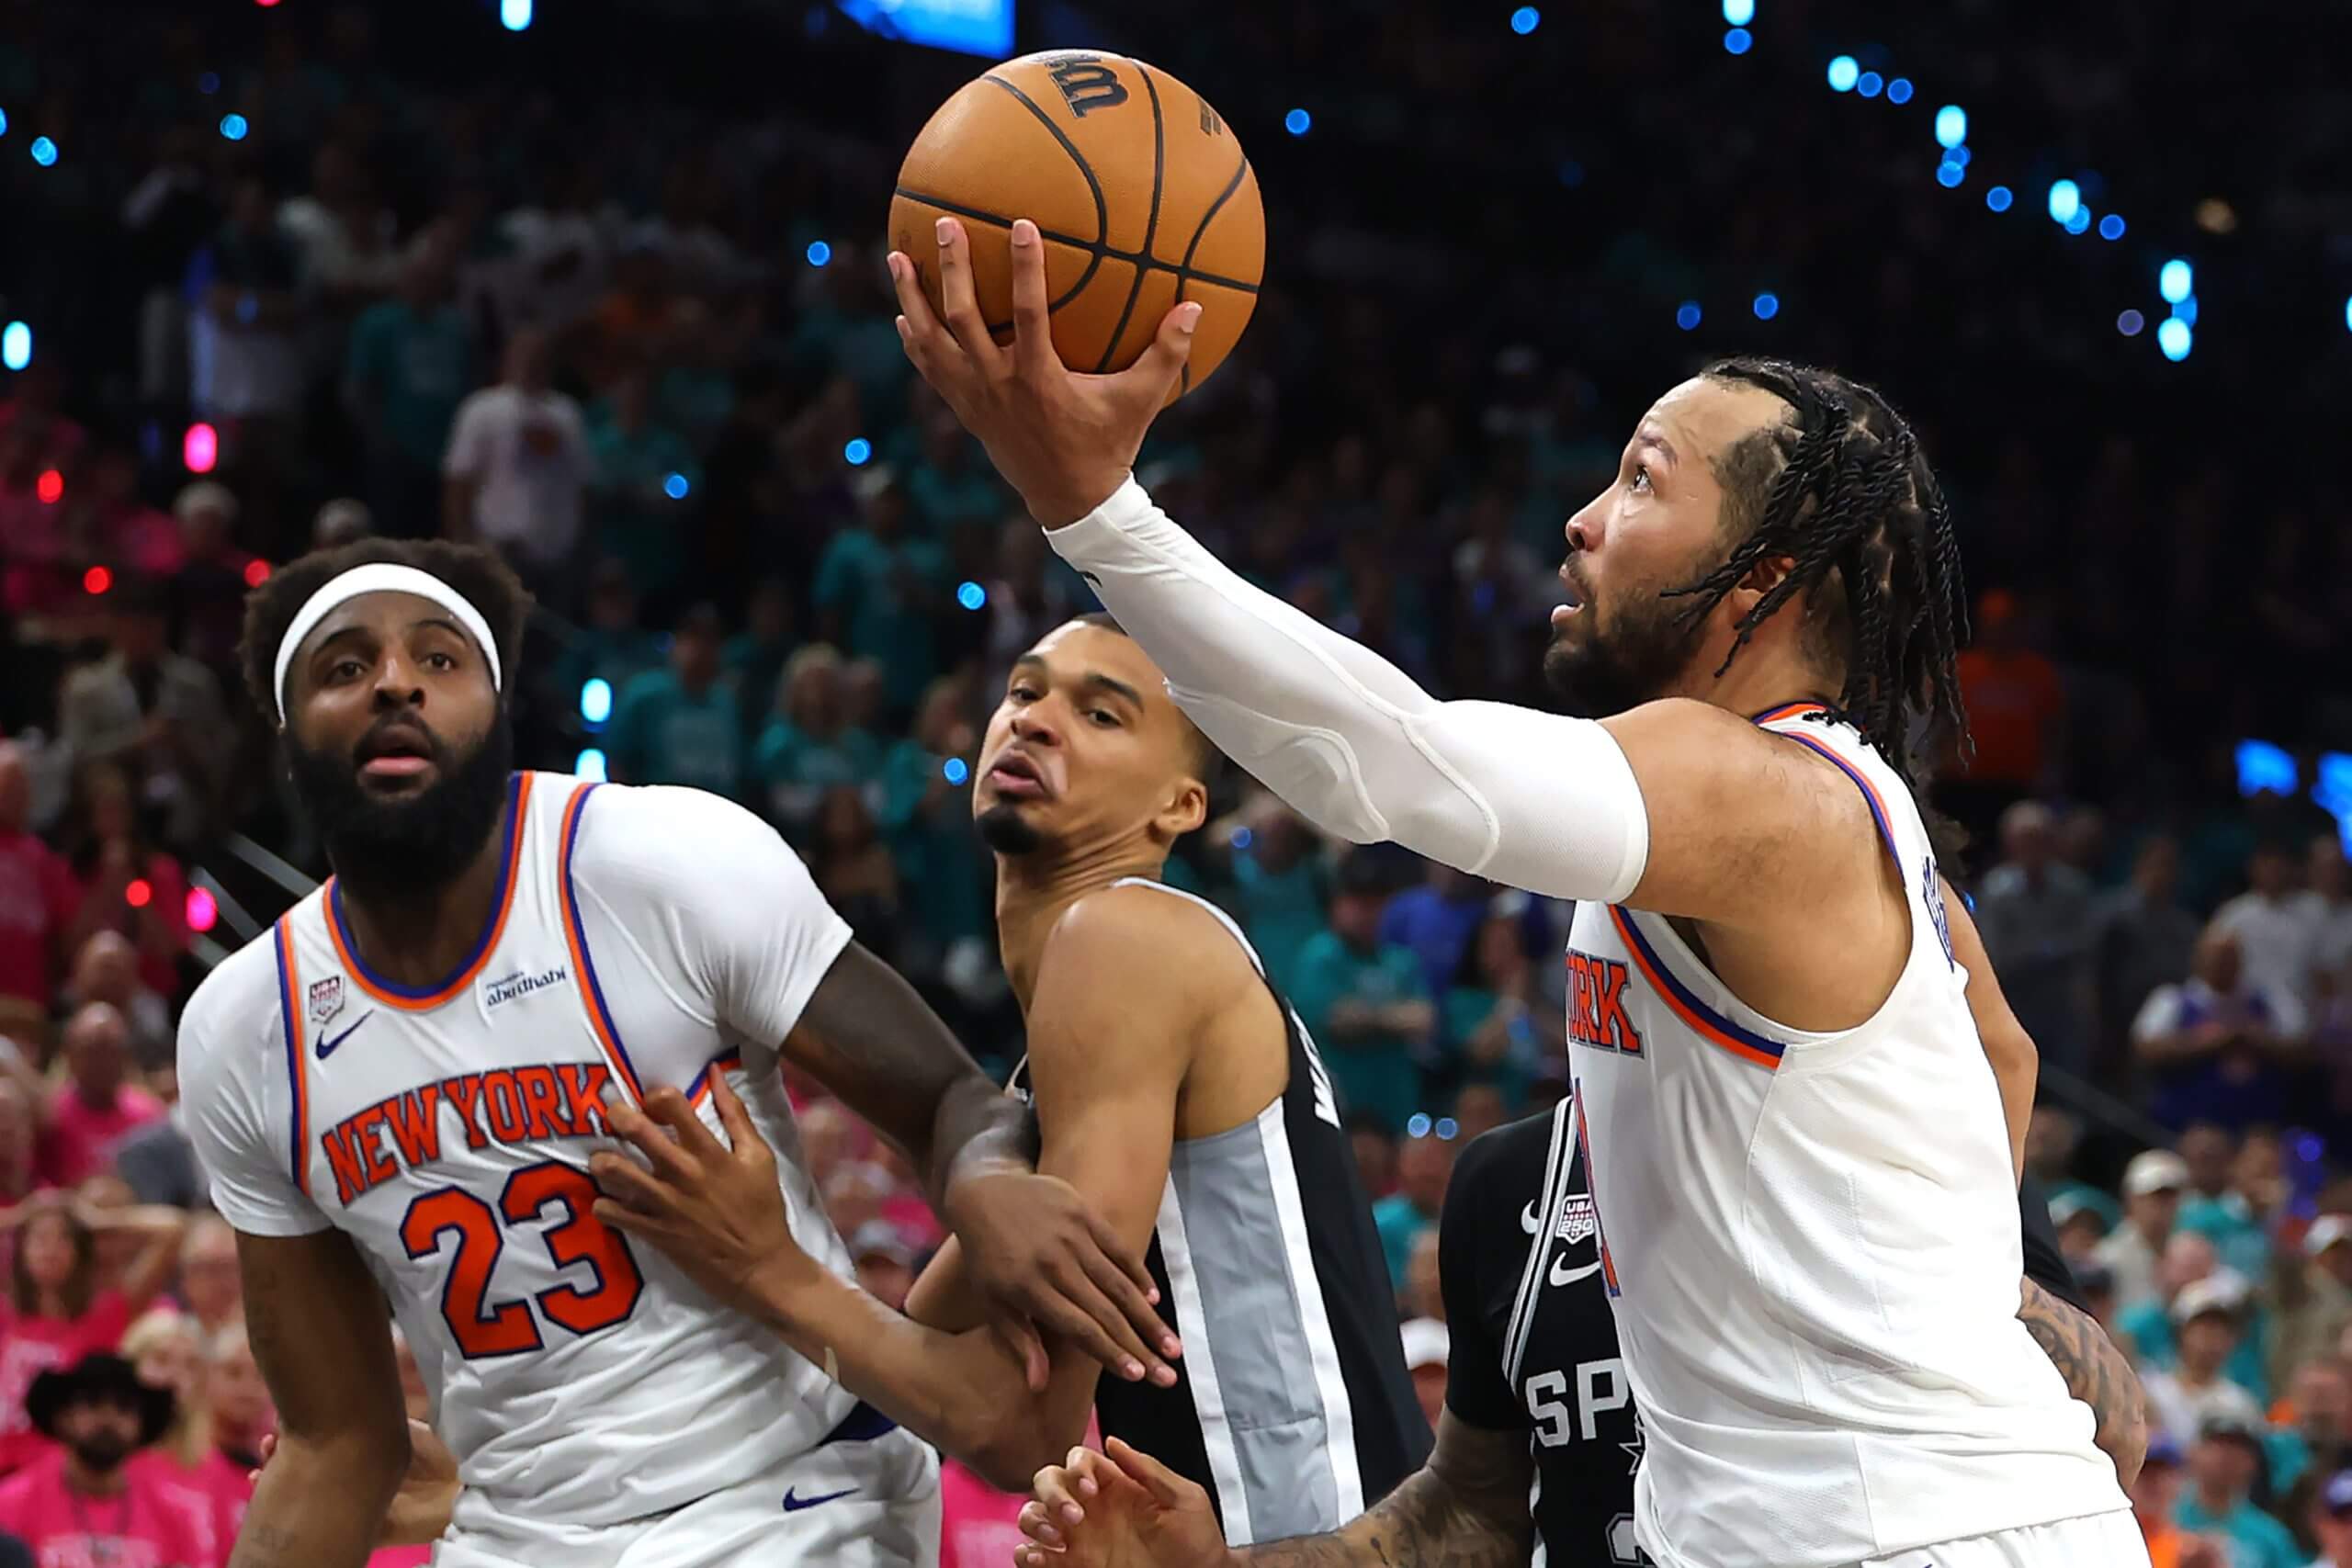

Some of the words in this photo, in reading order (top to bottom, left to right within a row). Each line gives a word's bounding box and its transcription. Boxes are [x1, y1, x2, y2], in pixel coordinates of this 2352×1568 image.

[322, 1084, 441, 1209] NEW
[442, 1063, 618, 1152] YORK
[400, 1160, 644, 1359] 23
[1560, 1219, 1594, 1233] 250
